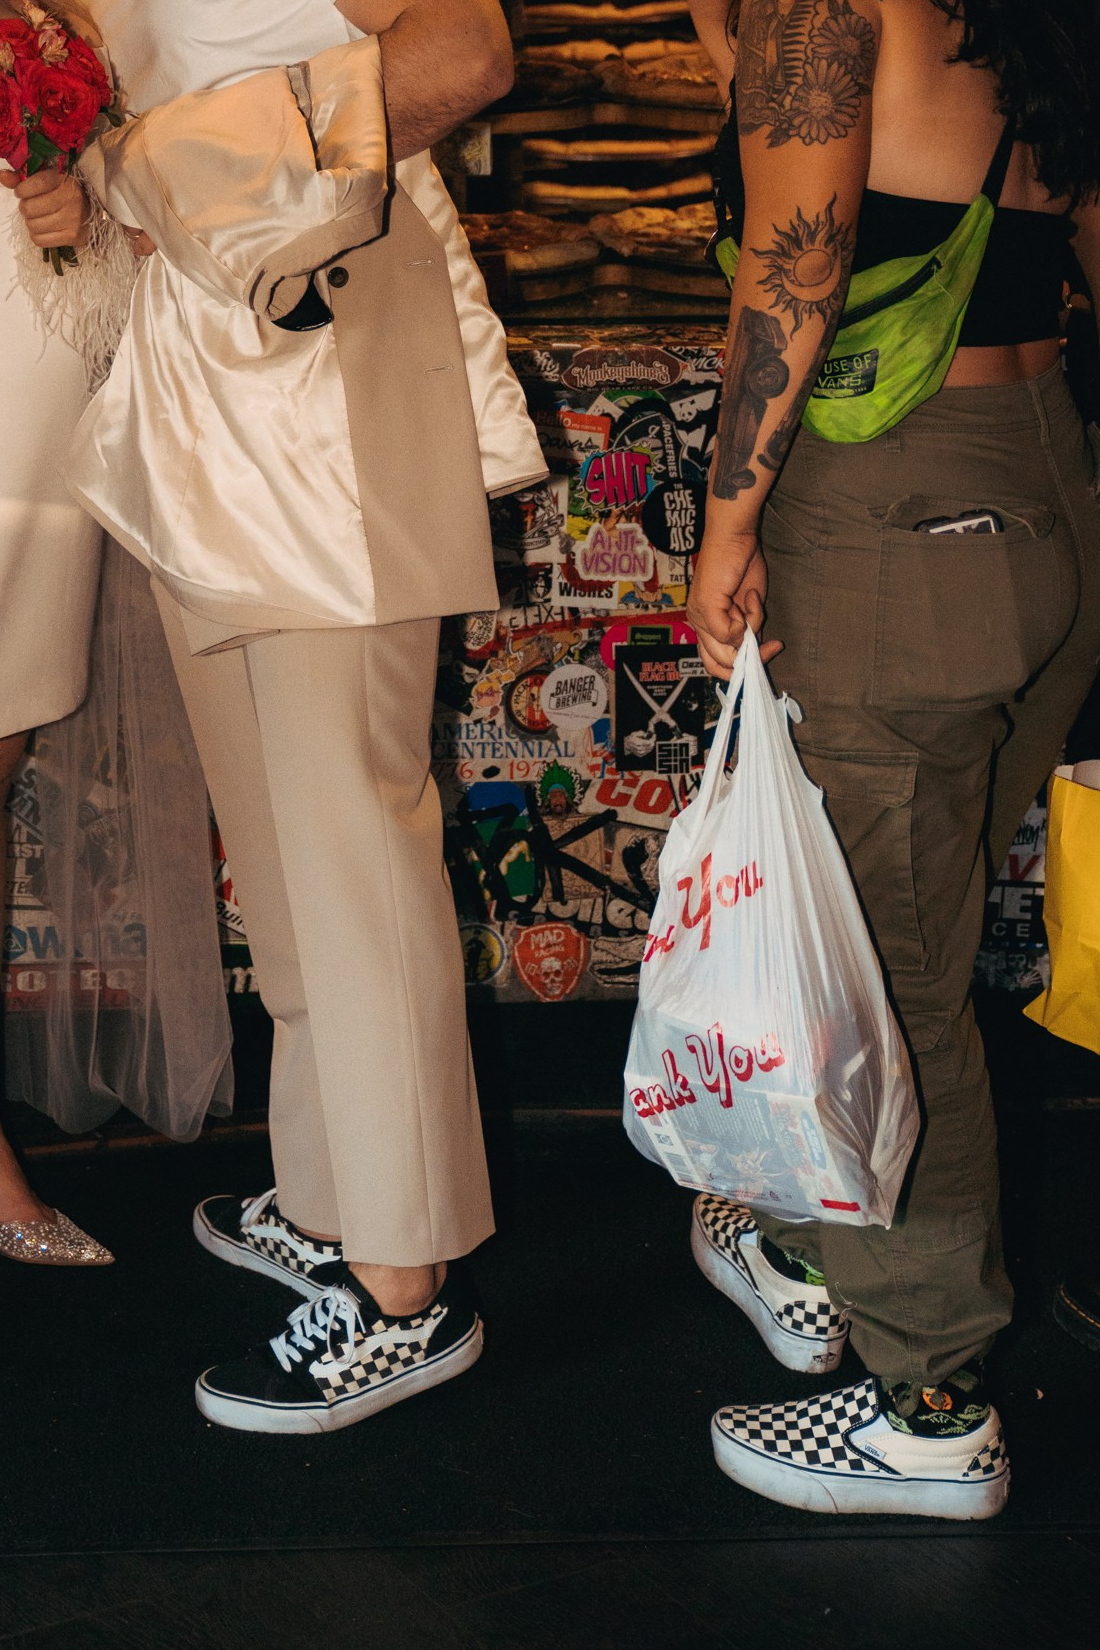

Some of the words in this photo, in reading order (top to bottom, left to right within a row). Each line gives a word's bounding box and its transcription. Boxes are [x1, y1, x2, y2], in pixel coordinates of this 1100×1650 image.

[824, 359, 849, 375] USE
[852, 353, 872, 370] OF
[817, 371, 862, 389] VANS
[585, 451, 650, 505] SHIT
[663, 489, 696, 510] CHE
[665, 509, 696, 528] MIC
[670, 526, 695, 552] ALS
[582, 552, 647, 575] VISION
[555, 675, 596, 695] BANGER
[555, 690, 593, 708] BREWING
[676, 852, 764, 951] You
[530, 929, 565, 949] MAD
[685, 1021, 786, 1110] You
